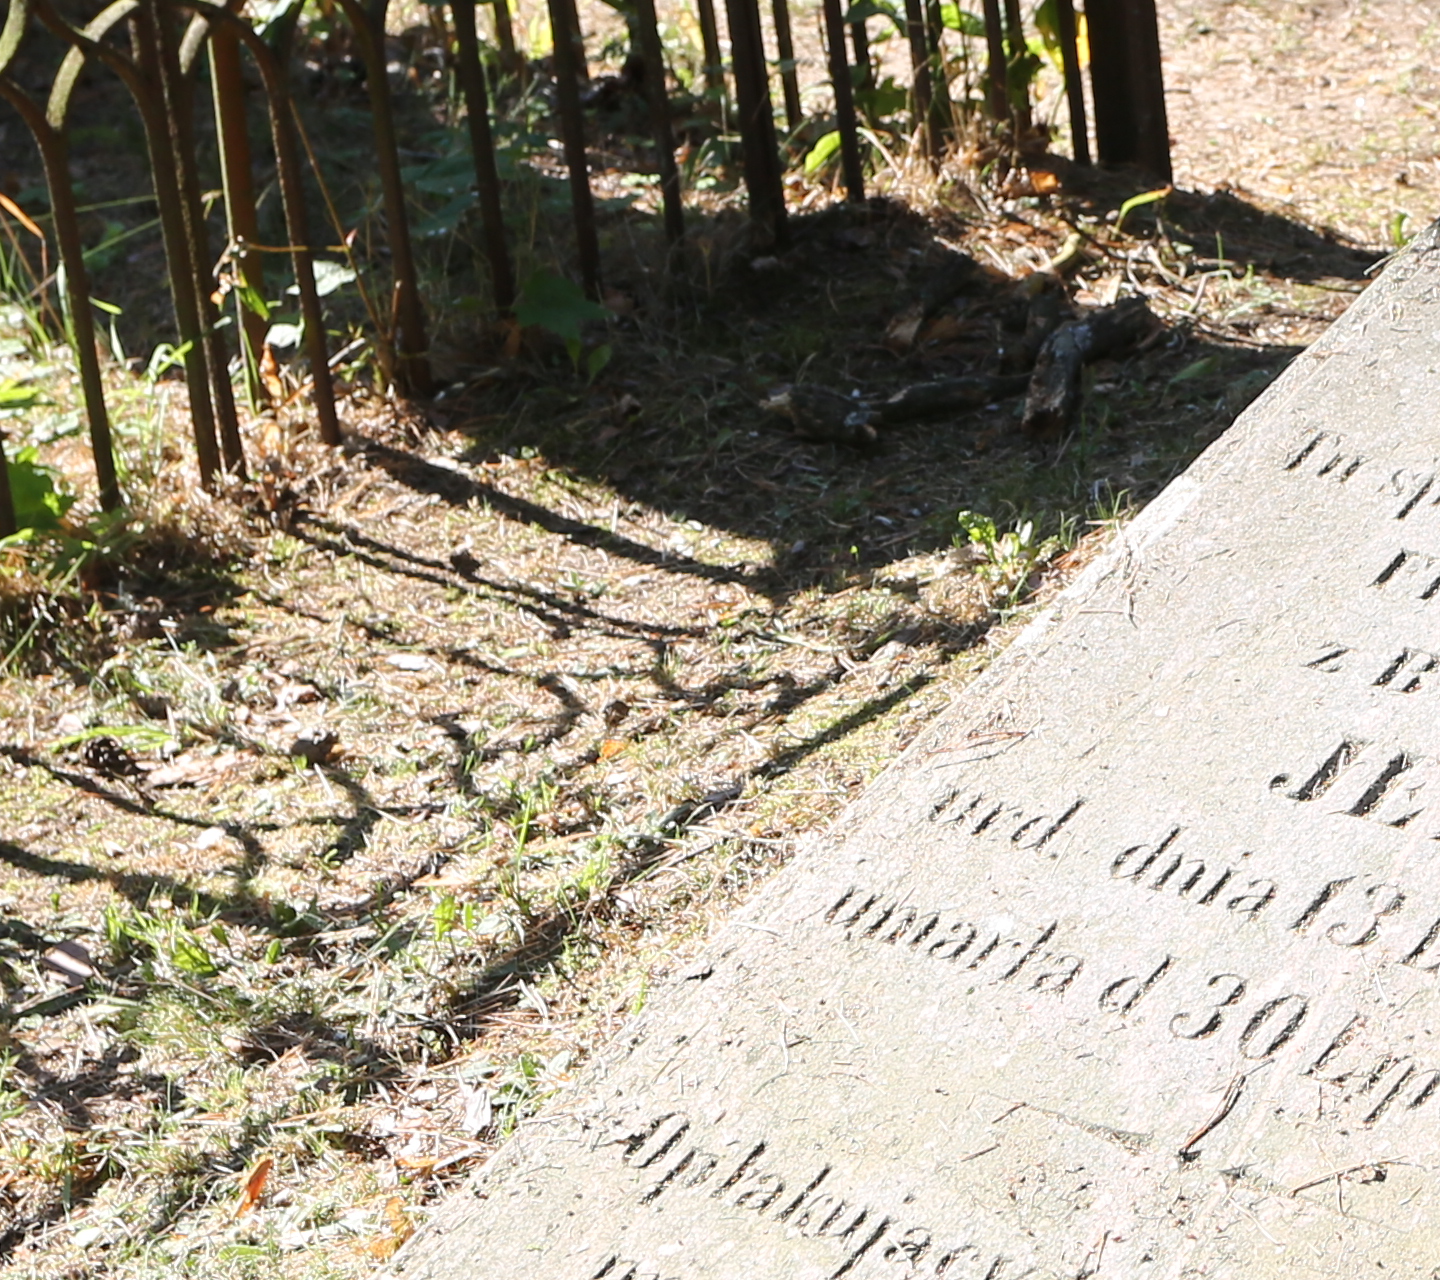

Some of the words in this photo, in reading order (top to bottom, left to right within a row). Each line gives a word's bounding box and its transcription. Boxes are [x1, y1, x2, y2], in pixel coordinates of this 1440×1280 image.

[1282, 426, 1367, 484] Tu
[1301, 641, 1358, 674] z
[1109, 823, 1277, 923] dnia
[1291, 875, 1406, 949] 13
[1169, 972, 1311, 1060] 30
